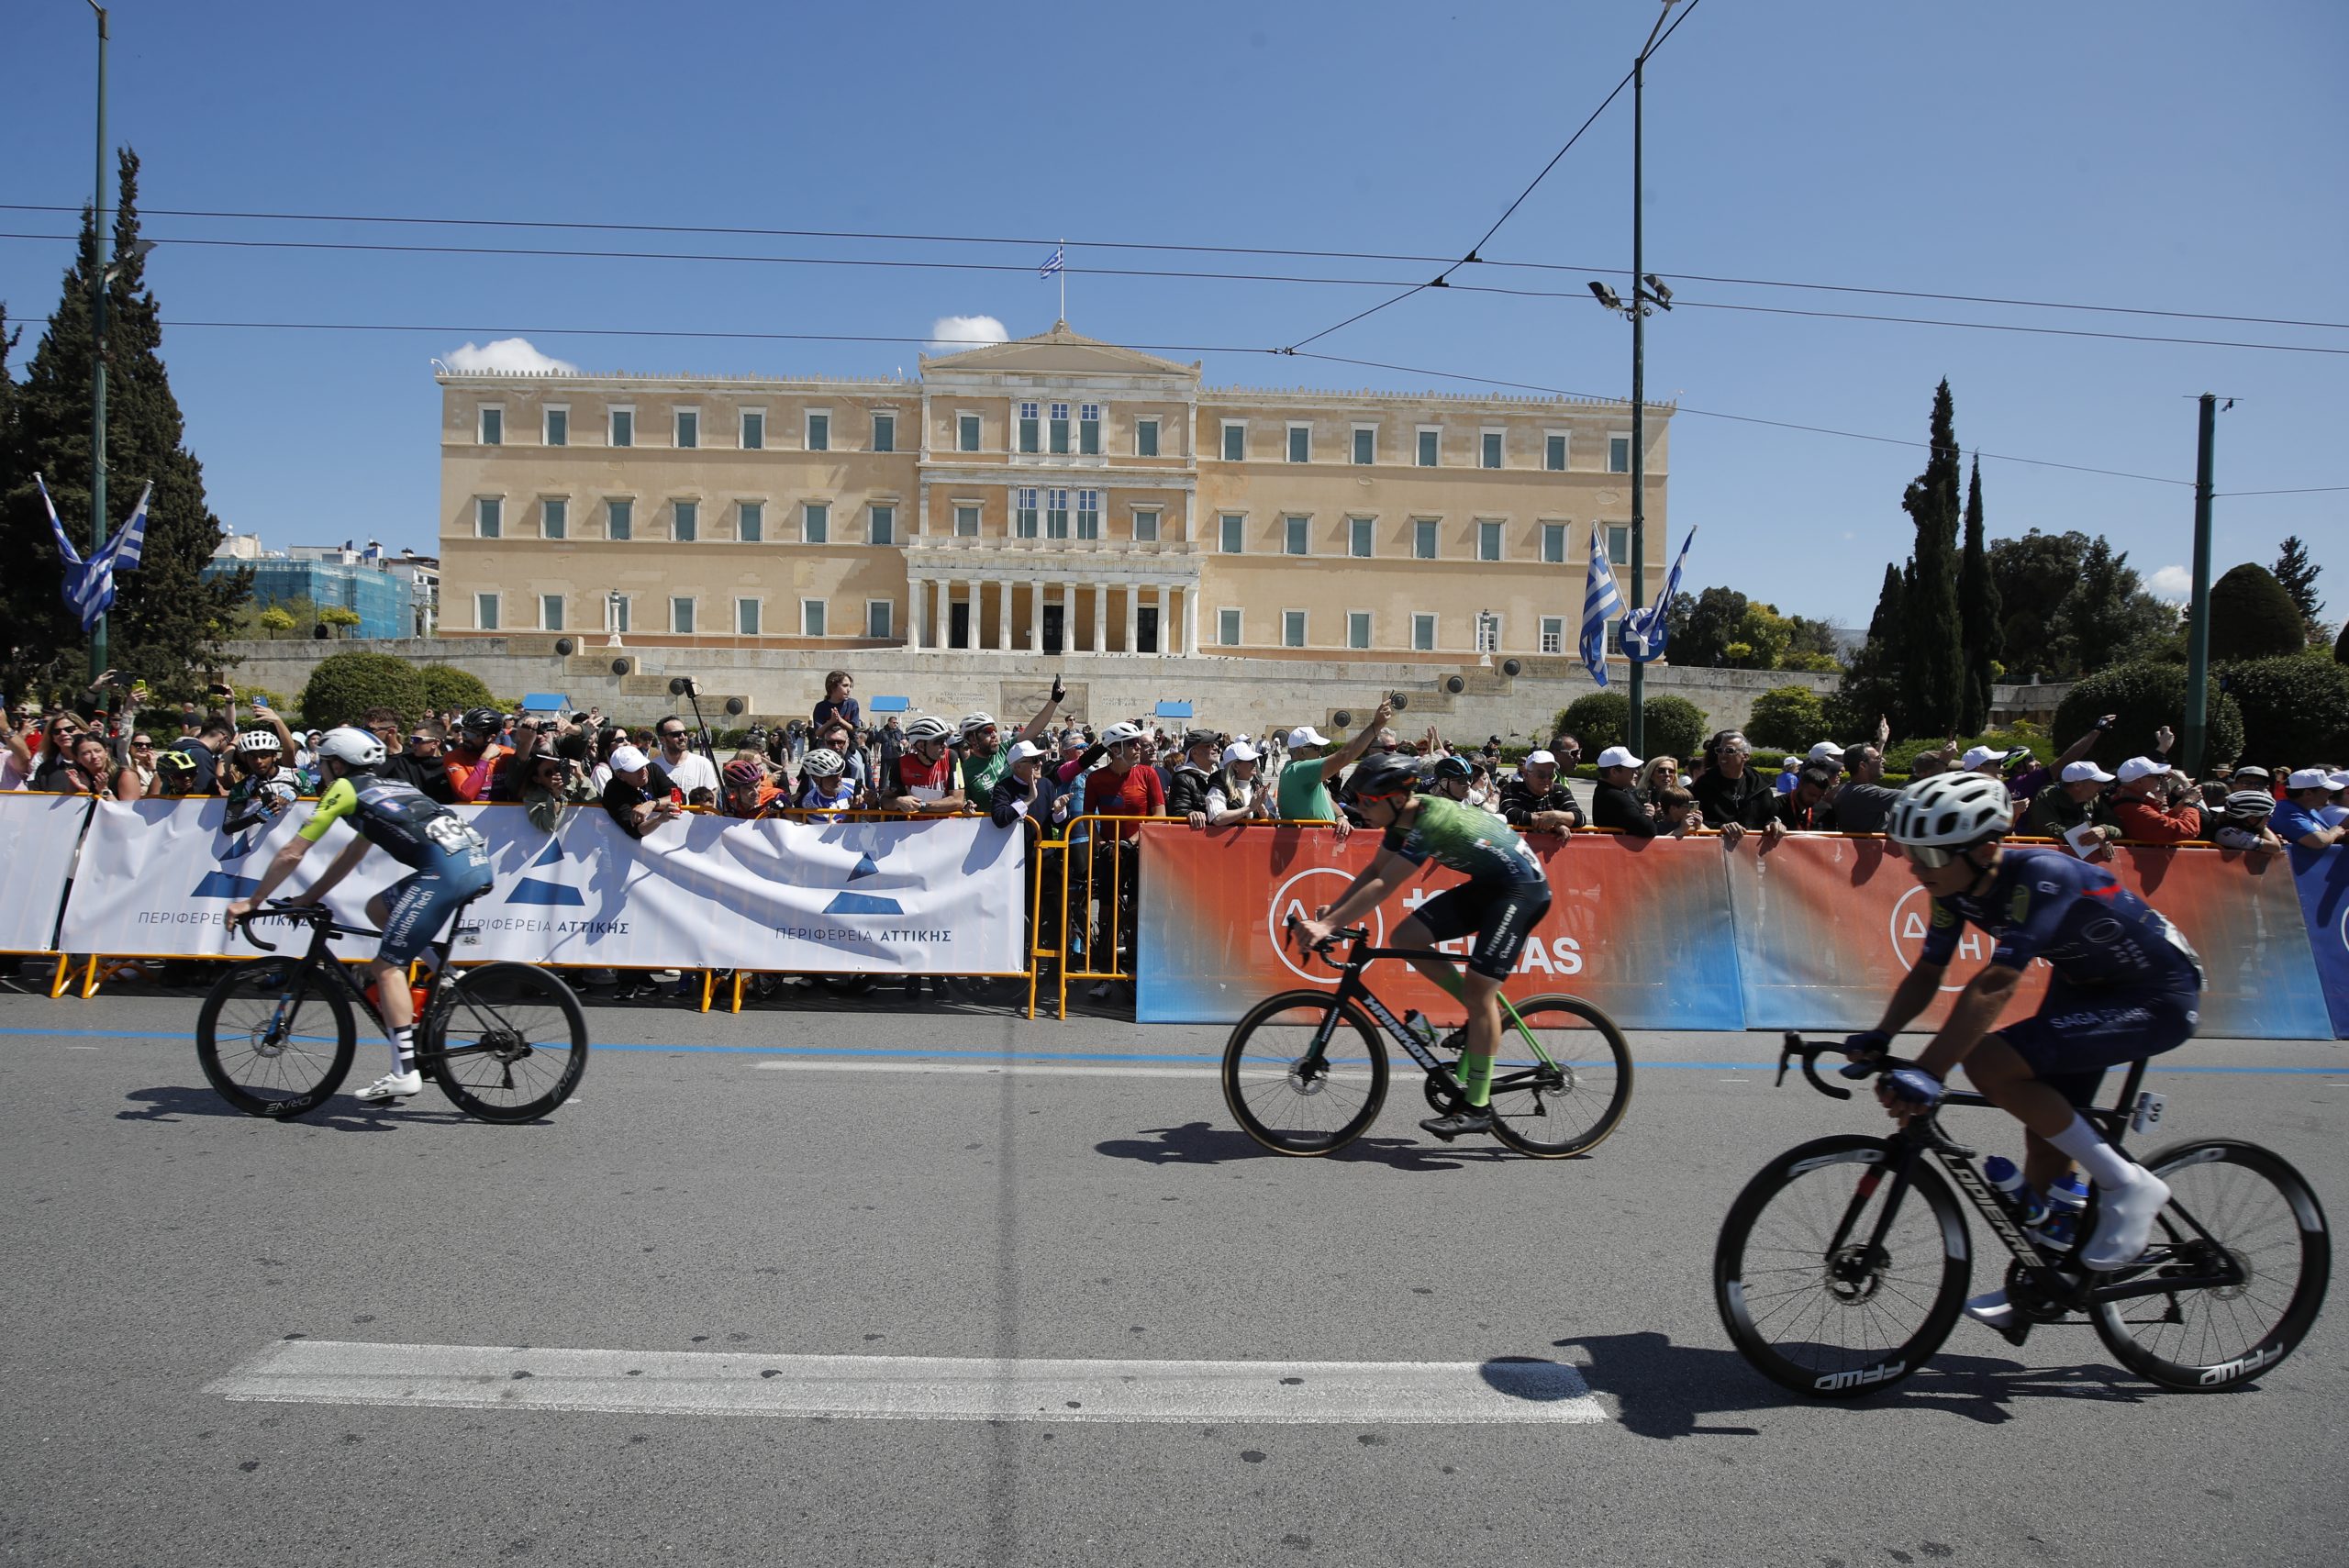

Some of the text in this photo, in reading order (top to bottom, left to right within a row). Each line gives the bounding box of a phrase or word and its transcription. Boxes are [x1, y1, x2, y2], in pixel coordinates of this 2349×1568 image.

[138, 911, 223, 926] ΠΕΡΙΦΕΡΕ
[557, 921, 629, 934] ΑΤΤΙΚΗΣ
[463, 936, 476, 945] 46
[775, 928, 952, 942] ΠΕΡΙΦΕΡΕΙΑ ΑΤΤΙΚΗΣ
[1363, 995, 1439, 1070] HRINKOW
[265, 1095, 312, 1114] DRIVE
[1939, 1153, 2046, 1267] LAPIERRE
[2199, 1342, 2284, 1386] FFWD
[1814, 1360, 1906, 1390] FFWD
